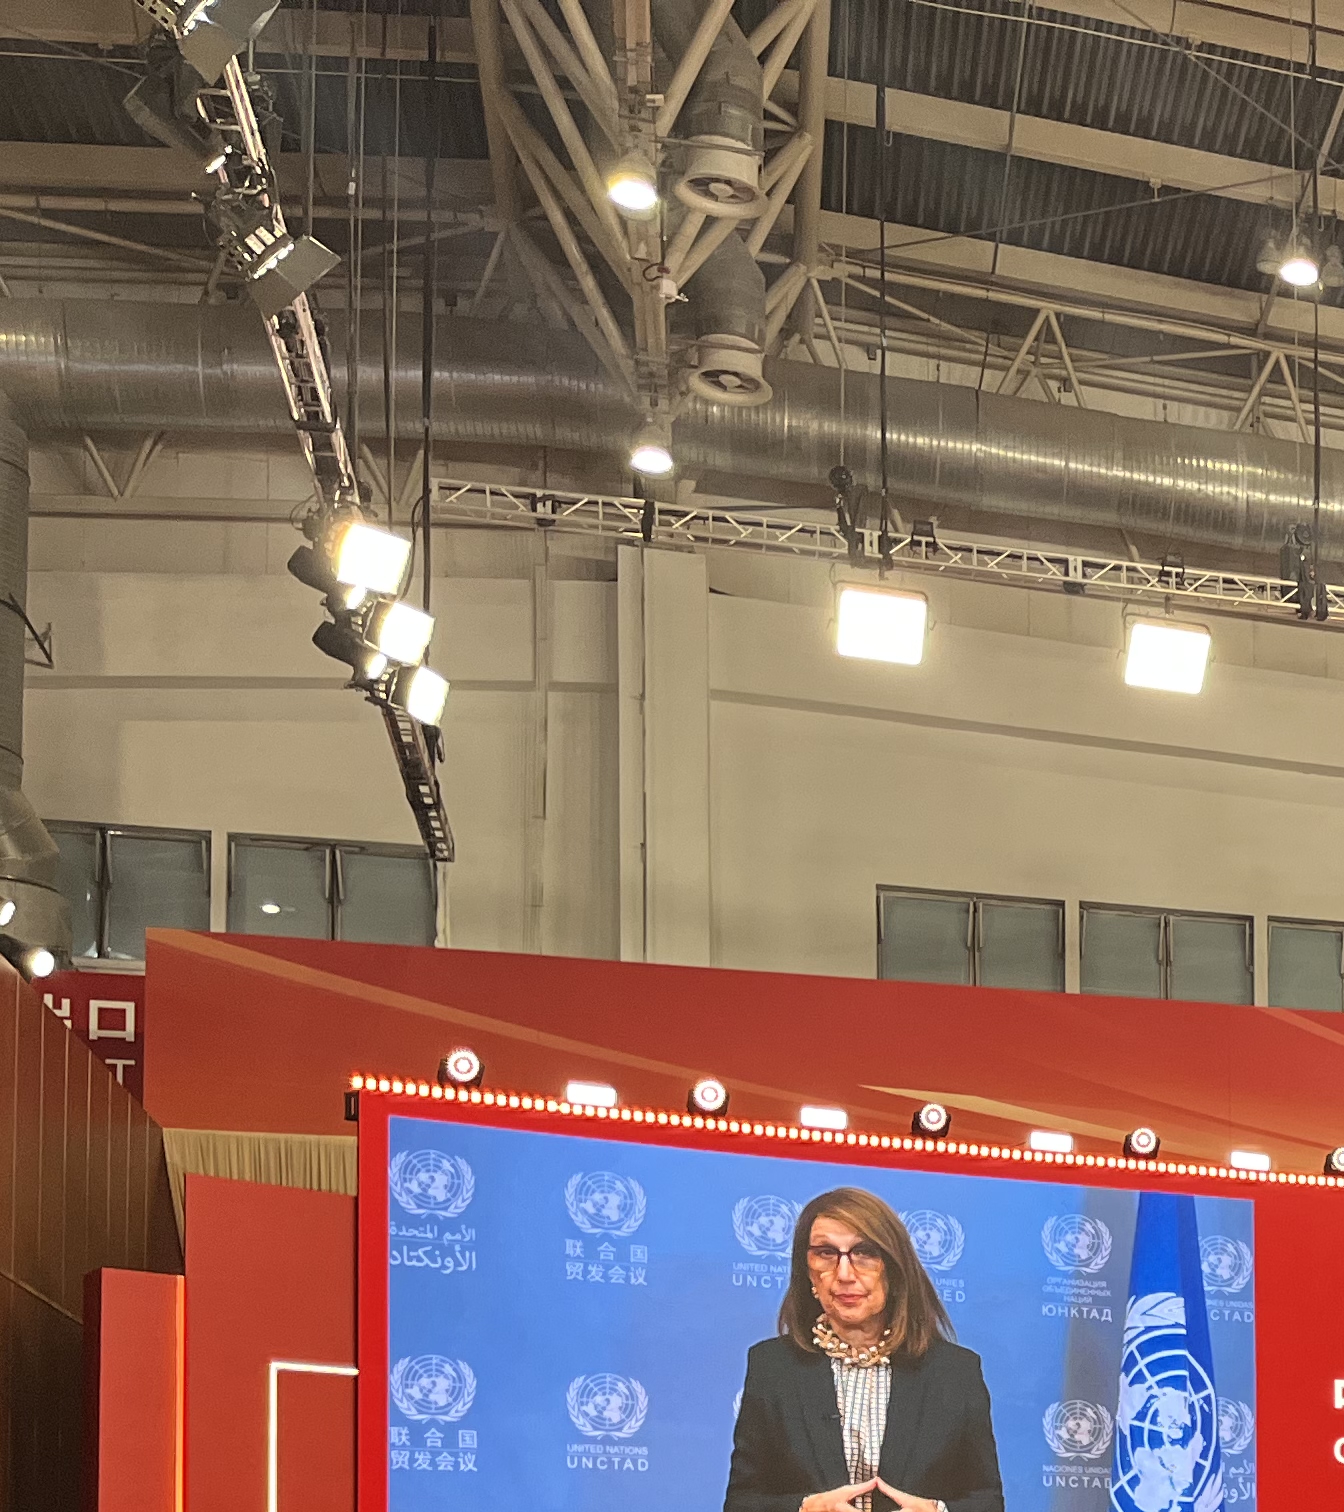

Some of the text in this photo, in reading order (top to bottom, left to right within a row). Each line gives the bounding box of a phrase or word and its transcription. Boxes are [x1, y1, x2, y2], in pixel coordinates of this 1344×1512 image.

[564, 1238, 649, 1264] 联合国
[565, 1261, 648, 1286] 贸发会议
[732, 1261, 769, 1273] UNITED
[732, 1273, 785, 1289] UNCT
[1041, 1304, 1113, 1323] ЮНКТАД
[1210, 1309, 1254, 1323] CTAD
[389, 1426, 478, 1448] 联合国
[566, 1443, 605, 1454] UNITED
[390, 1450, 478, 1472] 贸发会议
[566, 1456, 649, 1472] UNCTAD
